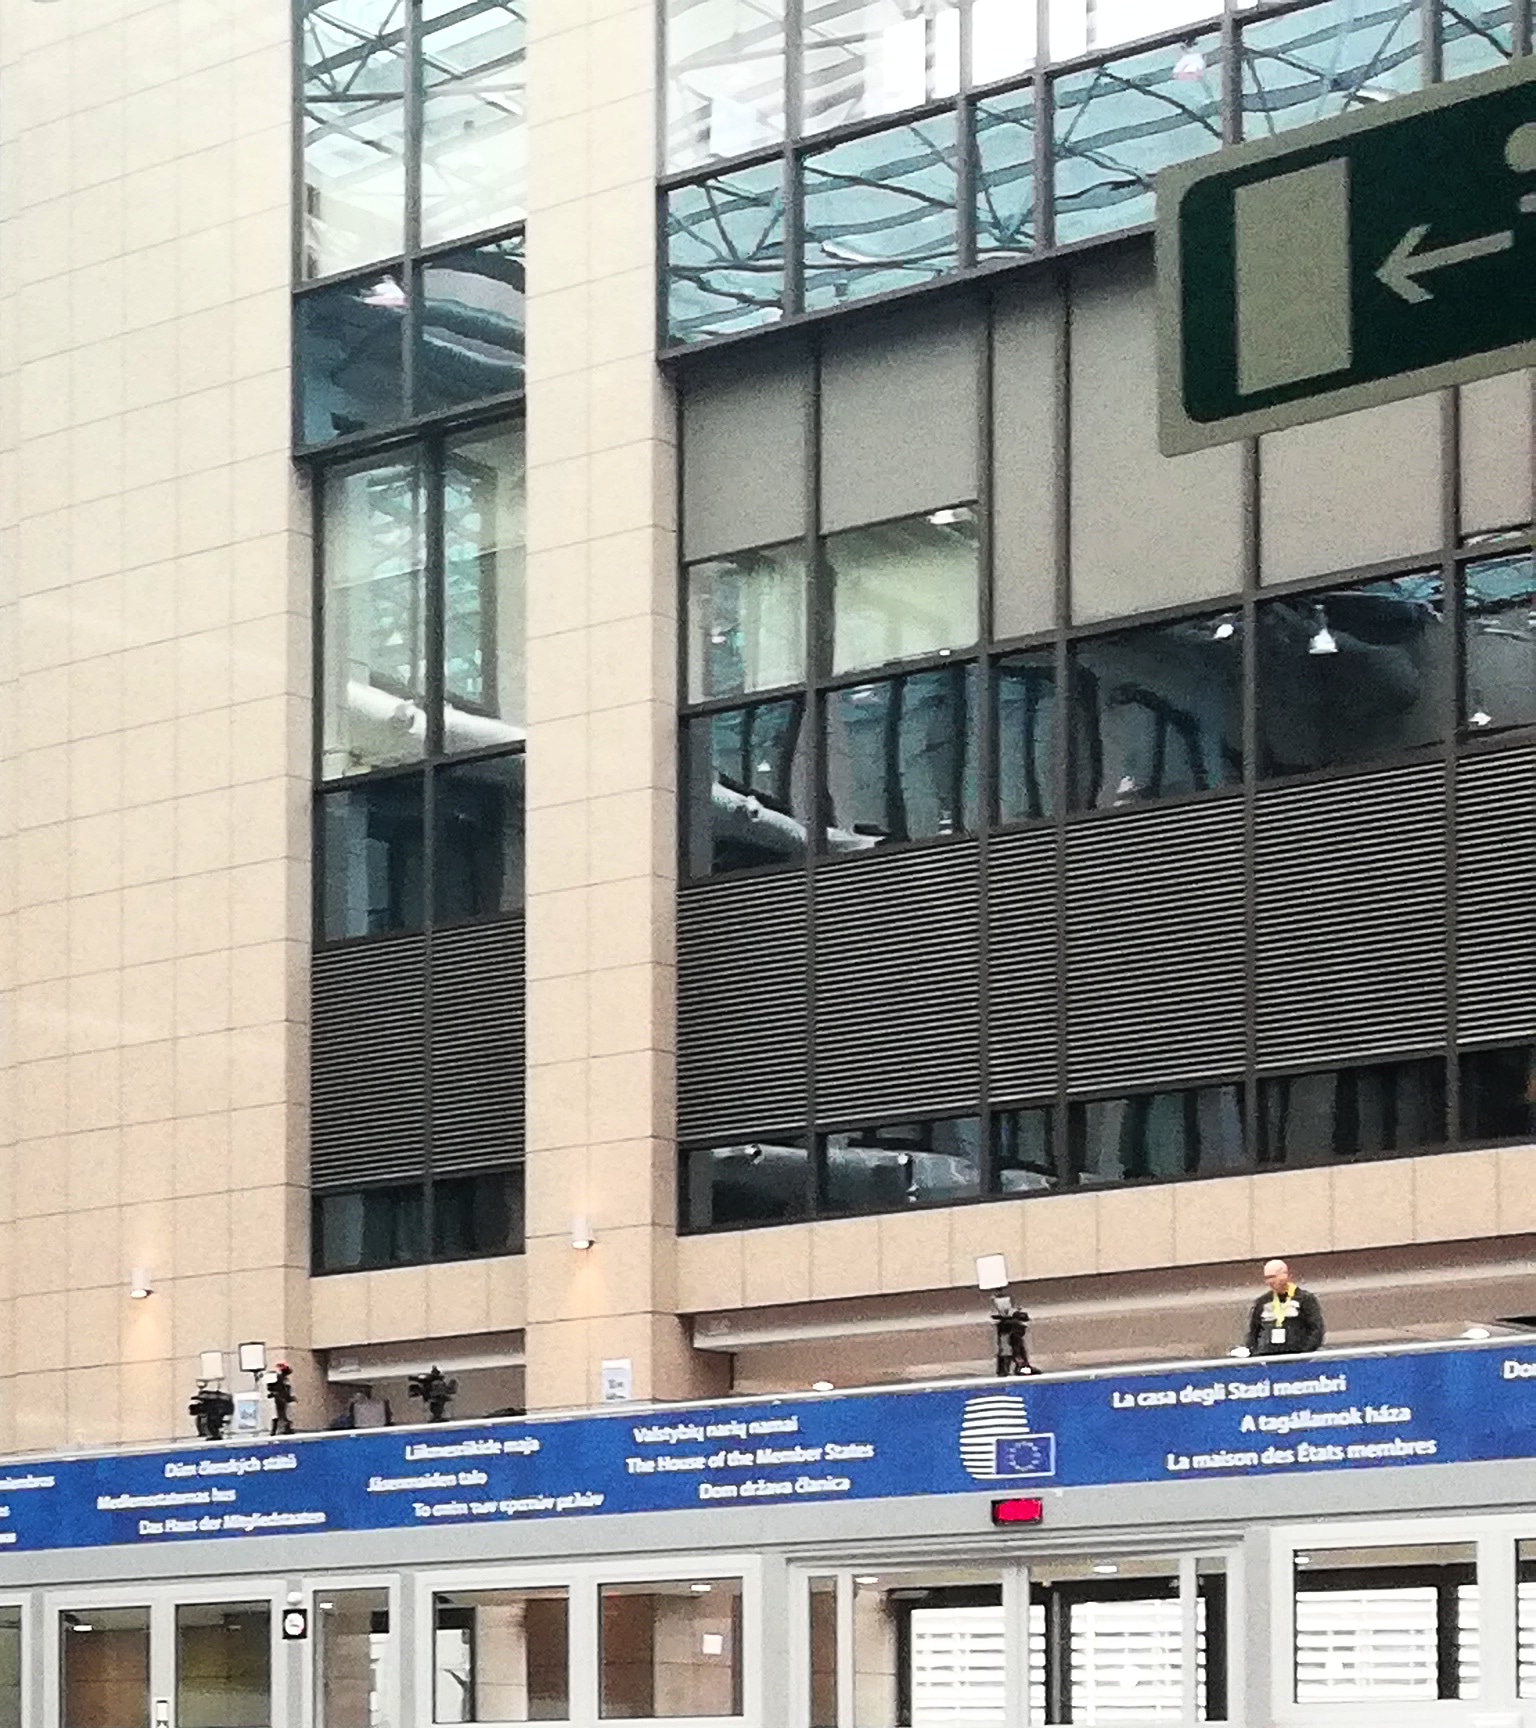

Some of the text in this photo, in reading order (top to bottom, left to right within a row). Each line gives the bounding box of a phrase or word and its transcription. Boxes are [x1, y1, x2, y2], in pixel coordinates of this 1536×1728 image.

[1503, 1359, 1536, 1380] Do
[1113, 1374, 1346, 1409] La casa degli Stati membri
[1240, 1403, 1412, 1434] A tagállamok háza
[626, 1444, 874, 1473] The House of the Member States
[1167, 1438, 1438, 1471] La maison des États membres
